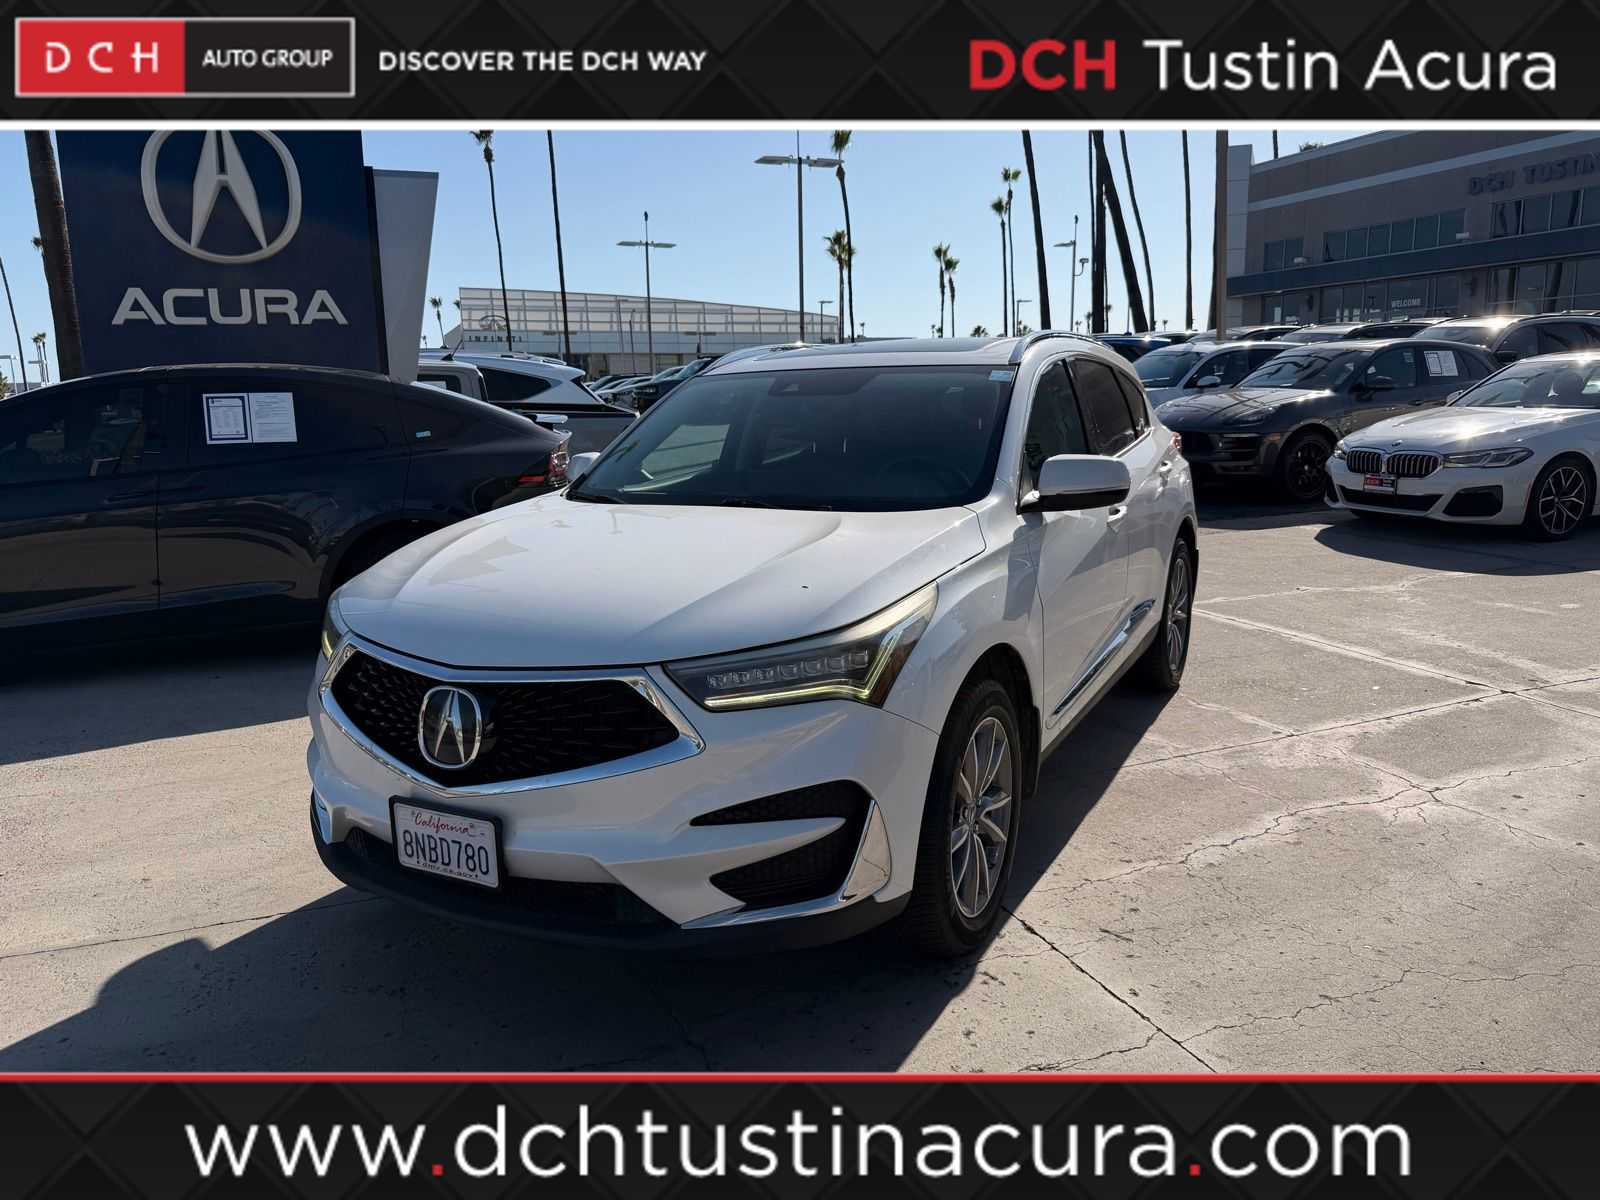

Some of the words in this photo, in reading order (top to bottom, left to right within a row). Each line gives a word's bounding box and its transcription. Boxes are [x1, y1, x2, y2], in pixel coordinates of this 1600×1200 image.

[111, 287, 348, 325] ACURA
[1391, 297, 1421, 309] WELCOME
[415, 811, 469, 833] California
[403, 829, 490, 875] 8NBD780
